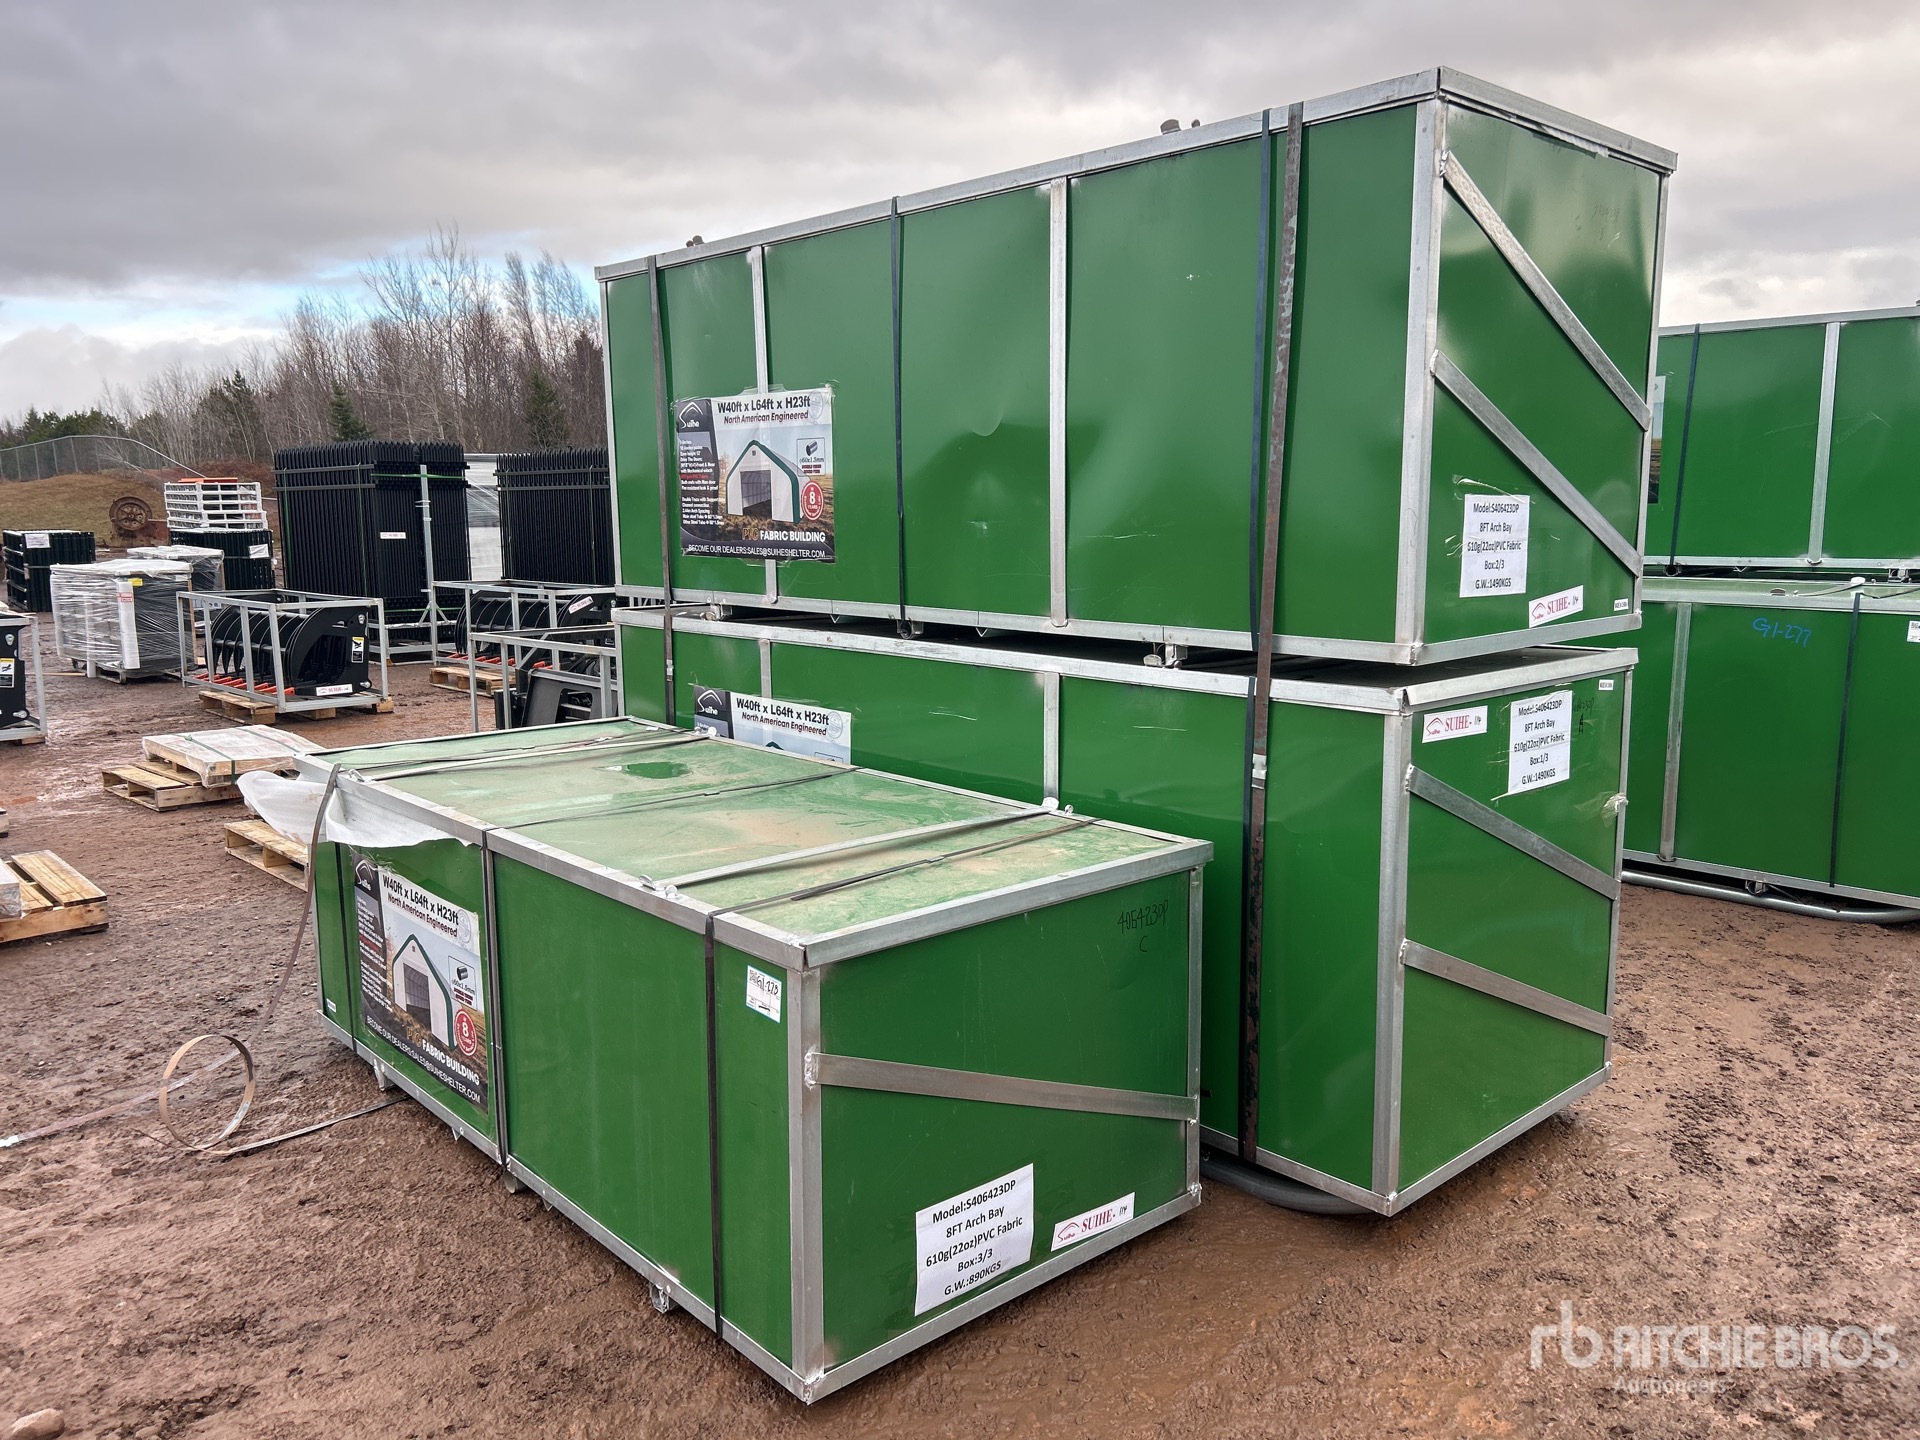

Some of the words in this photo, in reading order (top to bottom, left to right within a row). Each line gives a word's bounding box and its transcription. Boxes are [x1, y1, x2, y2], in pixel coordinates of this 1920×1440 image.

[718, 402, 742, 414] W40ft
[744, 403, 750, 411] x
[751, 399, 774, 411] L64ft
[777, 400, 783, 409] x
[785, 396, 810, 408] H23ft
[724, 414, 741, 425] North
[741, 413, 770, 423] American
[771, 410, 809, 423] Engineered
[809, 491, 816, 505] 8
[1473, 502, 1520, 514] Model:S406423DP
[1479, 522, 1490, 532] 8FT
[1489, 521, 1502, 532] Arch
[1502, 522, 1512, 534] Bay
[760, 530, 789, 541] FABRIC
[789, 531, 826, 543] BUILDING
[1506, 540, 1522, 550] Fabric
[688, 544, 710, 553] BECOME
[709, 545, 722, 553] OUR
[1484, 559, 1505, 572] Box:2/3
[736, 697, 761, 713] W40ft
[762, 705, 768, 714] x
[770, 704, 794, 719] L64ft
[796, 711, 802, 720] x
[804, 710, 830, 726] H23ft
[742, 712, 759, 723] North
[759, 715, 790, 728] American
[790, 721, 827, 736] Engineered
[1524, 722, 1534, 732] 8FT
[1534, 720, 1546, 731] Arch
[1546, 719, 1555, 729] Bay
[1550, 732, 1565, 743] Fabric
[1529, 752, 1549, 766] Box:1/3
[382, 874, 403, 897] W40ft
[404, 888, 409, 900] x
[410, 888, 429, 910] L64ft
[430, 902, 435, 914] x
[436, 903, 459, 926] H23ft
[387, 892, 402, 906] North
[401, 900, 426, 921] American
[426, 912, 458, 937] Engineered
[366, 1015, 382, 1035] BECOME
[382, 1029, 392, 1042] OUR
[462, 1021, 469, 1038] 8
[422, 1038, 445, 1064] FABRIC
[445, 1055, 480, 1086] BUILDING
[932, 1179, 1016, 1224] Model:S406423DP
[946, 1222, 963, 1238] 8FT
[965, 1213, 986, 1231] Arch
[988, 1206, 1005, 1220] Bay
[926, 1227, 995, 1267] 610g(22oz)PVC
[997, 1217, 1023, 1236] Fabric
[957, 1248, 993, 1272] Box:3/3
[944, 1260, 1001, 1296] G.W.:890KGS
